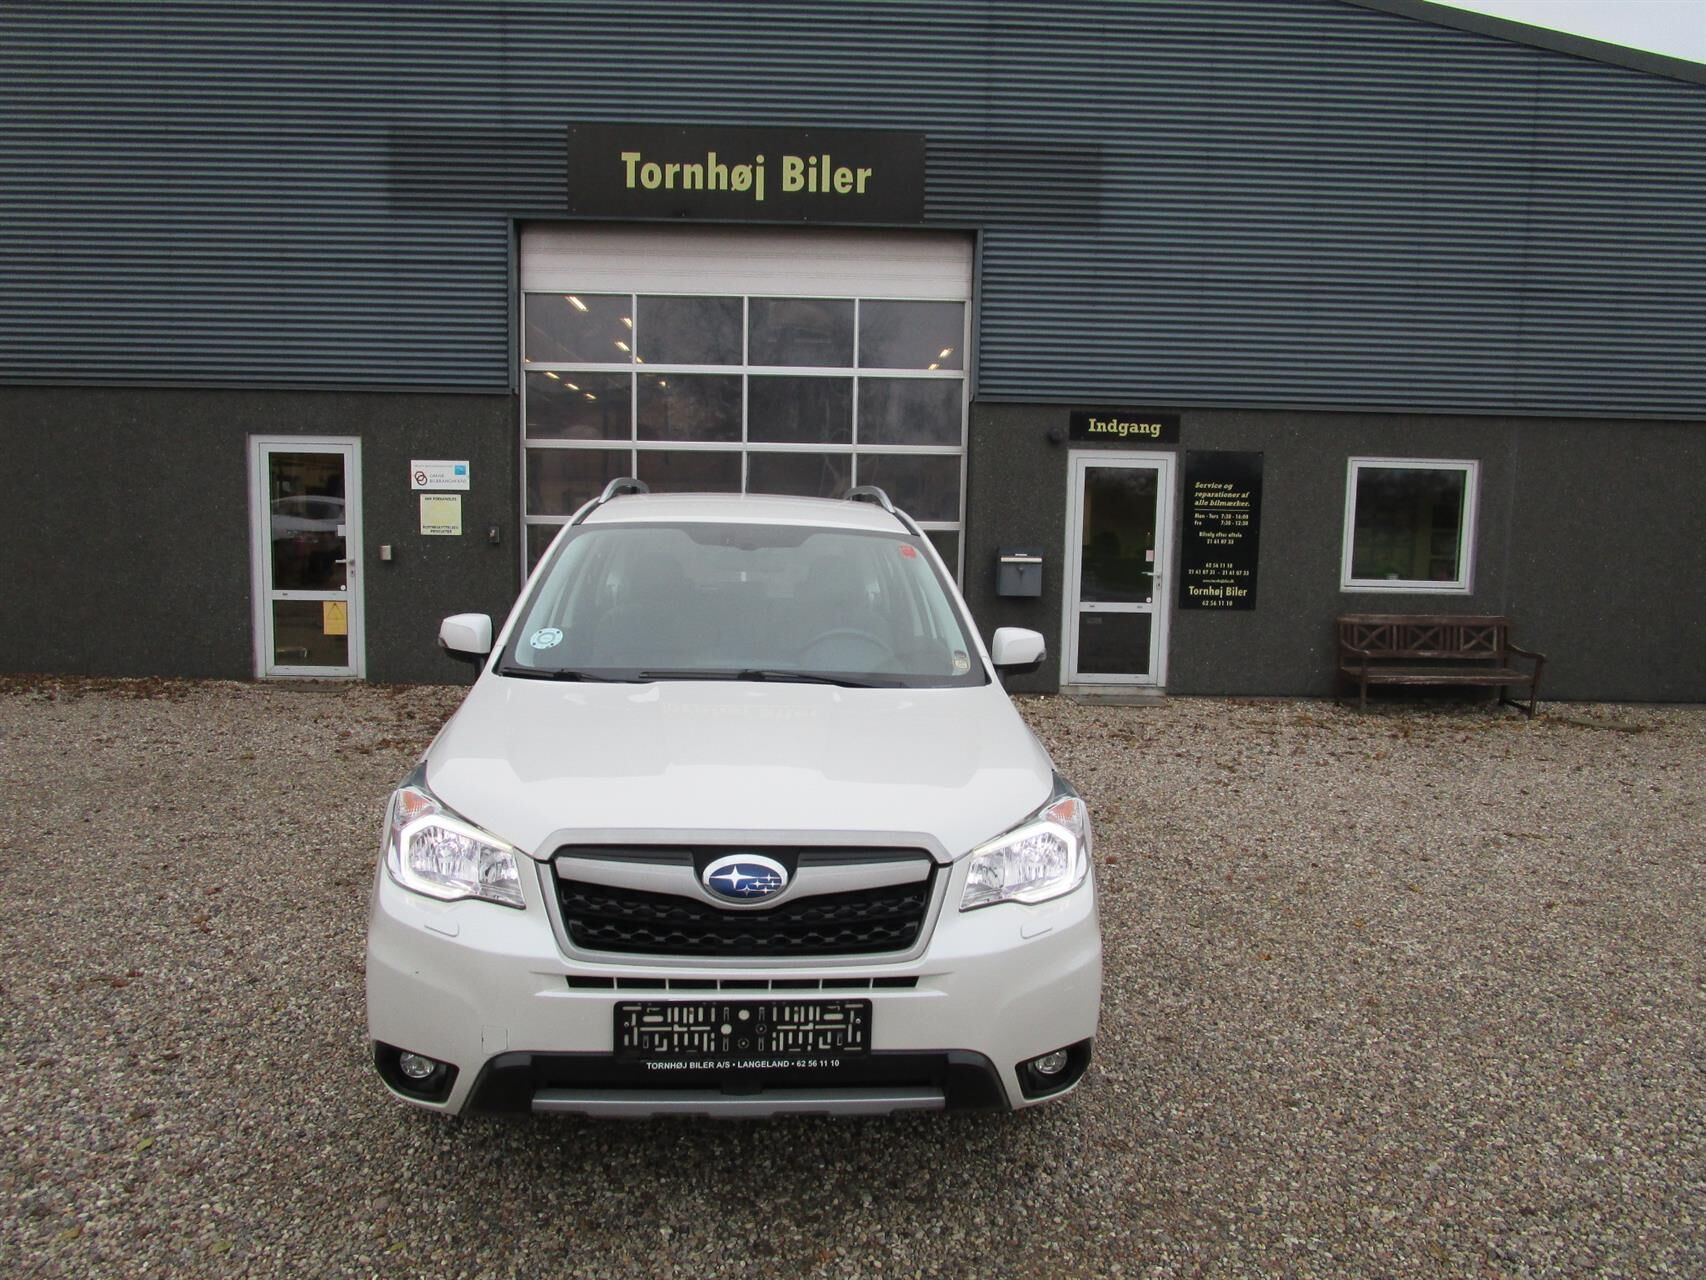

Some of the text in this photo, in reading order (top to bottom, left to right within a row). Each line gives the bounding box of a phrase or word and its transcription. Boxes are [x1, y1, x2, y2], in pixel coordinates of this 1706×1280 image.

[621, 151, 872, 201] Tornhøj Biler
[1088, 418, 1162, 438] Indgang
[1194, 491, 1240, 499] reparationer
[1189, 585, 1248, 599] Tornhøj Biler
[646, 1061, 688, 1070] TORNHØJ
[689, 1061, 715, 1069] BILER
[716, 1061, 731, 1069] A/S
[737, 1060, 790, 1068] LANGELAND
[796, 1060, 806, 1068] 62
[831, 1059, 840, 1067] 10
